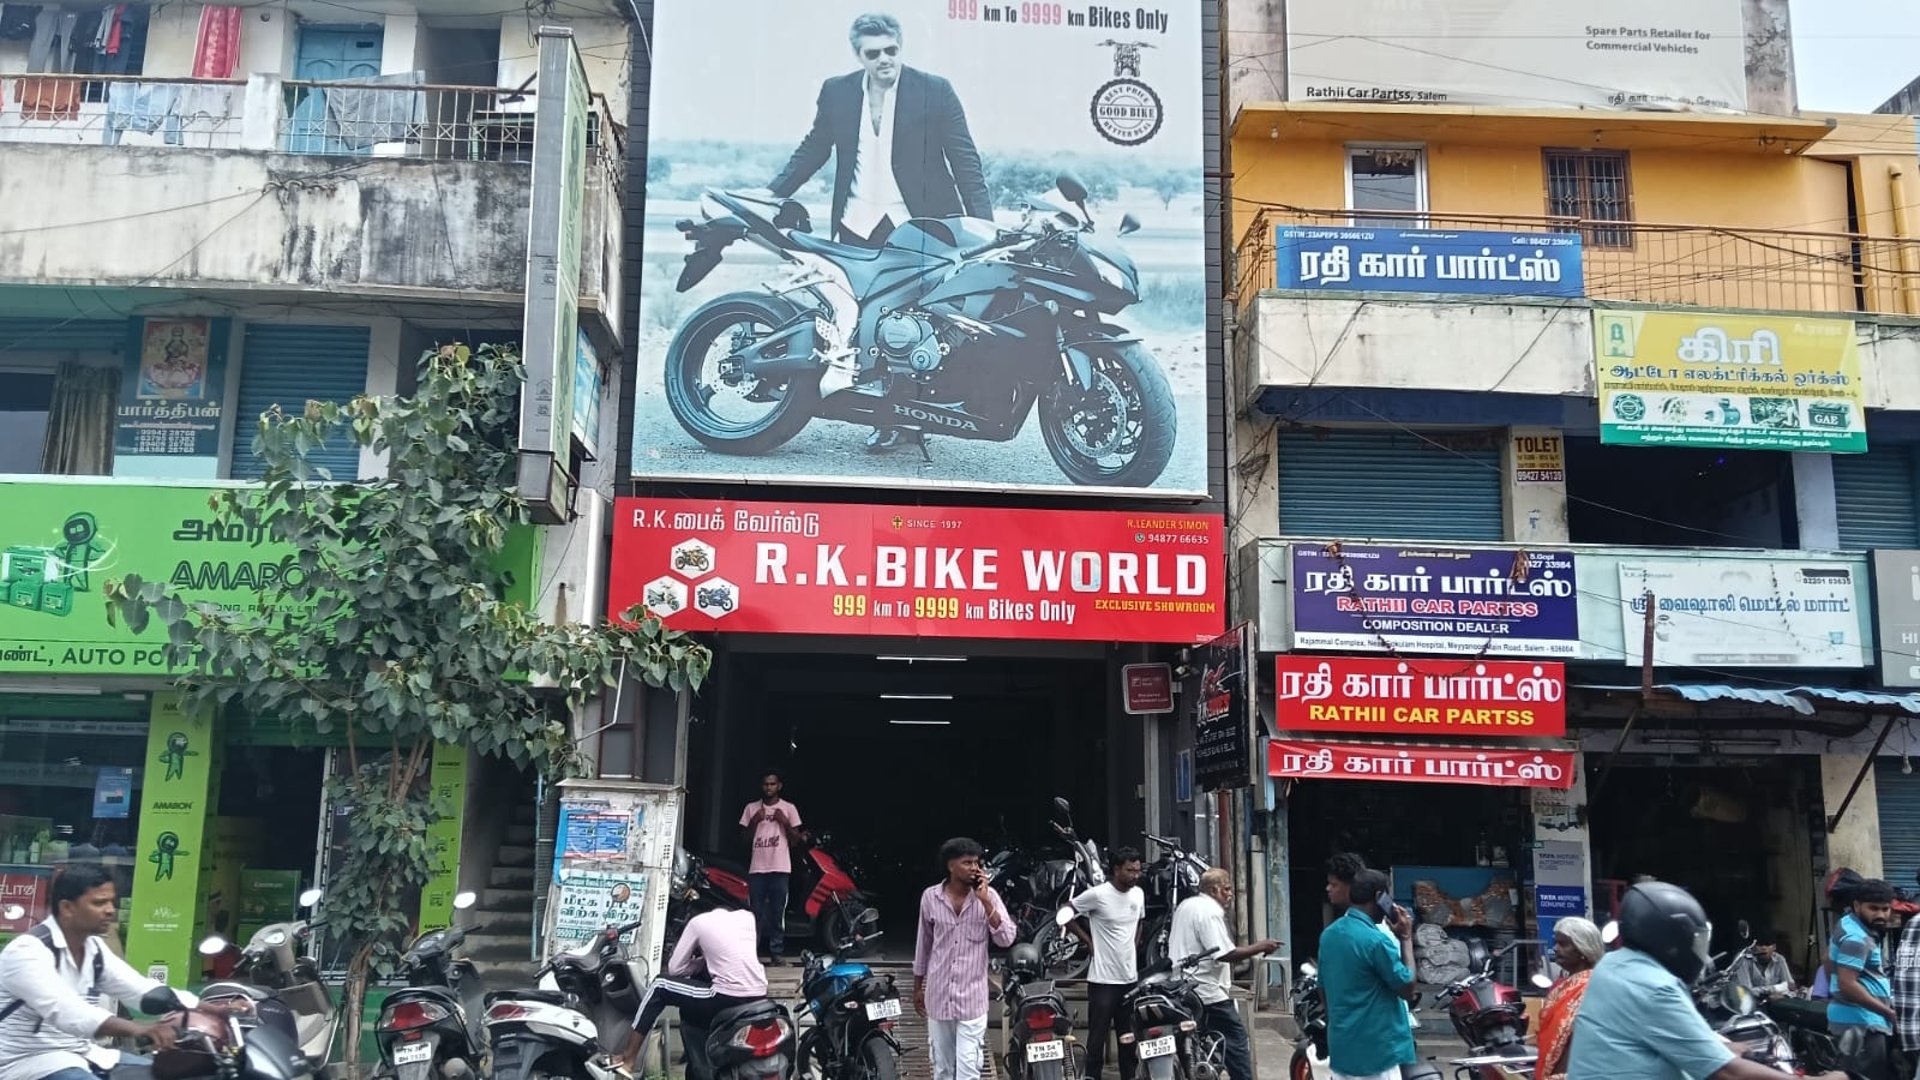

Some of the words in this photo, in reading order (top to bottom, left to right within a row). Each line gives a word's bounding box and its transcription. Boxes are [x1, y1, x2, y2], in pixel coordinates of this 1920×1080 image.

[948, 0, 977, 20] 999
[984, 5, 1001, 22] km
[1005, 6, 1017, 23] To
[1021, 2, 1062, 25] 9999
[1067, 10, 1085, 26] km
[1089, 6, 1131, 29] Bikes
[1136, 8, 1168, 34] Only
[1585, 25, 1617, 37] Spare
[1620, 27, 1648, 37] Parts
[1650, 28, 1692, 39] Retailer
[1695, 30, 1711, 40] for
[1586, 40, 1652, 52] Commercial
[1653, 43, 1699, 54] Vehicles
[1104, 86, 1123, 102] BEST
[1126, 86, 1149, 103] PRICE
[1306, 87, 1344, 97] Rathii
[1347, 88, 1368, 98] Car
[1372, 88, 1414, 101] Partss,
[1417, 91, 1447, 101] Salem
[1099, 107, 1127, 117] GOOD
[1130, 107, 1155, 118] BIKE
[1300, 245, 1351, 286] ரதி
[1359, 246, 1427, 278] கார்
[1436, 247, 1561, 283] பார்ட்ஸ்
[1678, 326, 1782, 366] கிரி
[1610, 364, 1680, 380] ஆட்டோ
[118, 400, 221, 419] பார்த்திபன்
[893, 403, 979, 432] HONDA
[1515, 437, 1559, 453] TOLET
[633, 508, 725, 531] R.K.பைக்
[734, 509, 819, 537] வேர்ல்டு
[906, 519, 936, 529] SINCE
[941, 520, 962, 529] 1997
[1127, 519, 1177, 530] R.LEANDER
[1178, 520, 1210, 531] SIMON
[1147, 534, 1178, 544] 94877
[1179, 534, 1210, 545] 66635
[170, 560, 308, 590] AMARO
[754, 542, 999, 591] R.K.BIKE
[1022, 548, 1208, 597] WORLD
[1304, 565, 1355, 595] ரதி
[1364, 566, 1432, 592] கார்
[1441, 568, 1572, 597] பார்ட்ஸ்
[833, 594, 865, 616] 999
[873, 599, 892, 617] km
[896, 600, 910, 618] To
[914, 596, 959, 619] 9999
[965, 602, 984, 620] km
[988, 599, 1034, 621] Bikes
[1039, 599, 1076, 624] Only
[1095, 599, 1153, 612] EXCLUSIVE
[1154, 600, 1216, 613] SHOWROOM
[1337, 597, 1407, 613] RATHII
[1411, 600, 1456, 615] CAR
[1458, 601, 1540, 618] PARTSS
[1659, 594, 1736, 615] வைஷாலி
[1804, 593, 1851, 613] மார்ட்
[1363, 619, 1454, 633] COMPOSITION
[1457, 622, 1510, 635] DEALER
[1300, 637, 1333, 646] Rajammal
[61, 648, 125, 666] AUTO
[1279, 662, 1333, 704] ரதி
[1342, 662, 1415, 699] கார்
[1424, 664, 1562, 703] பார்ட்ஸ்
[1310, 705, 1387, 722] RATHII
[1393, 707, 1440, 723] CAR
[1446, 708, 1535, 725] PARTSS
[1281, 748, 1334, 776] ரதி
[1344, 751, 1416, 774] கார்
[1425, 753, 1562, 781] பார்ட்ஸ்
